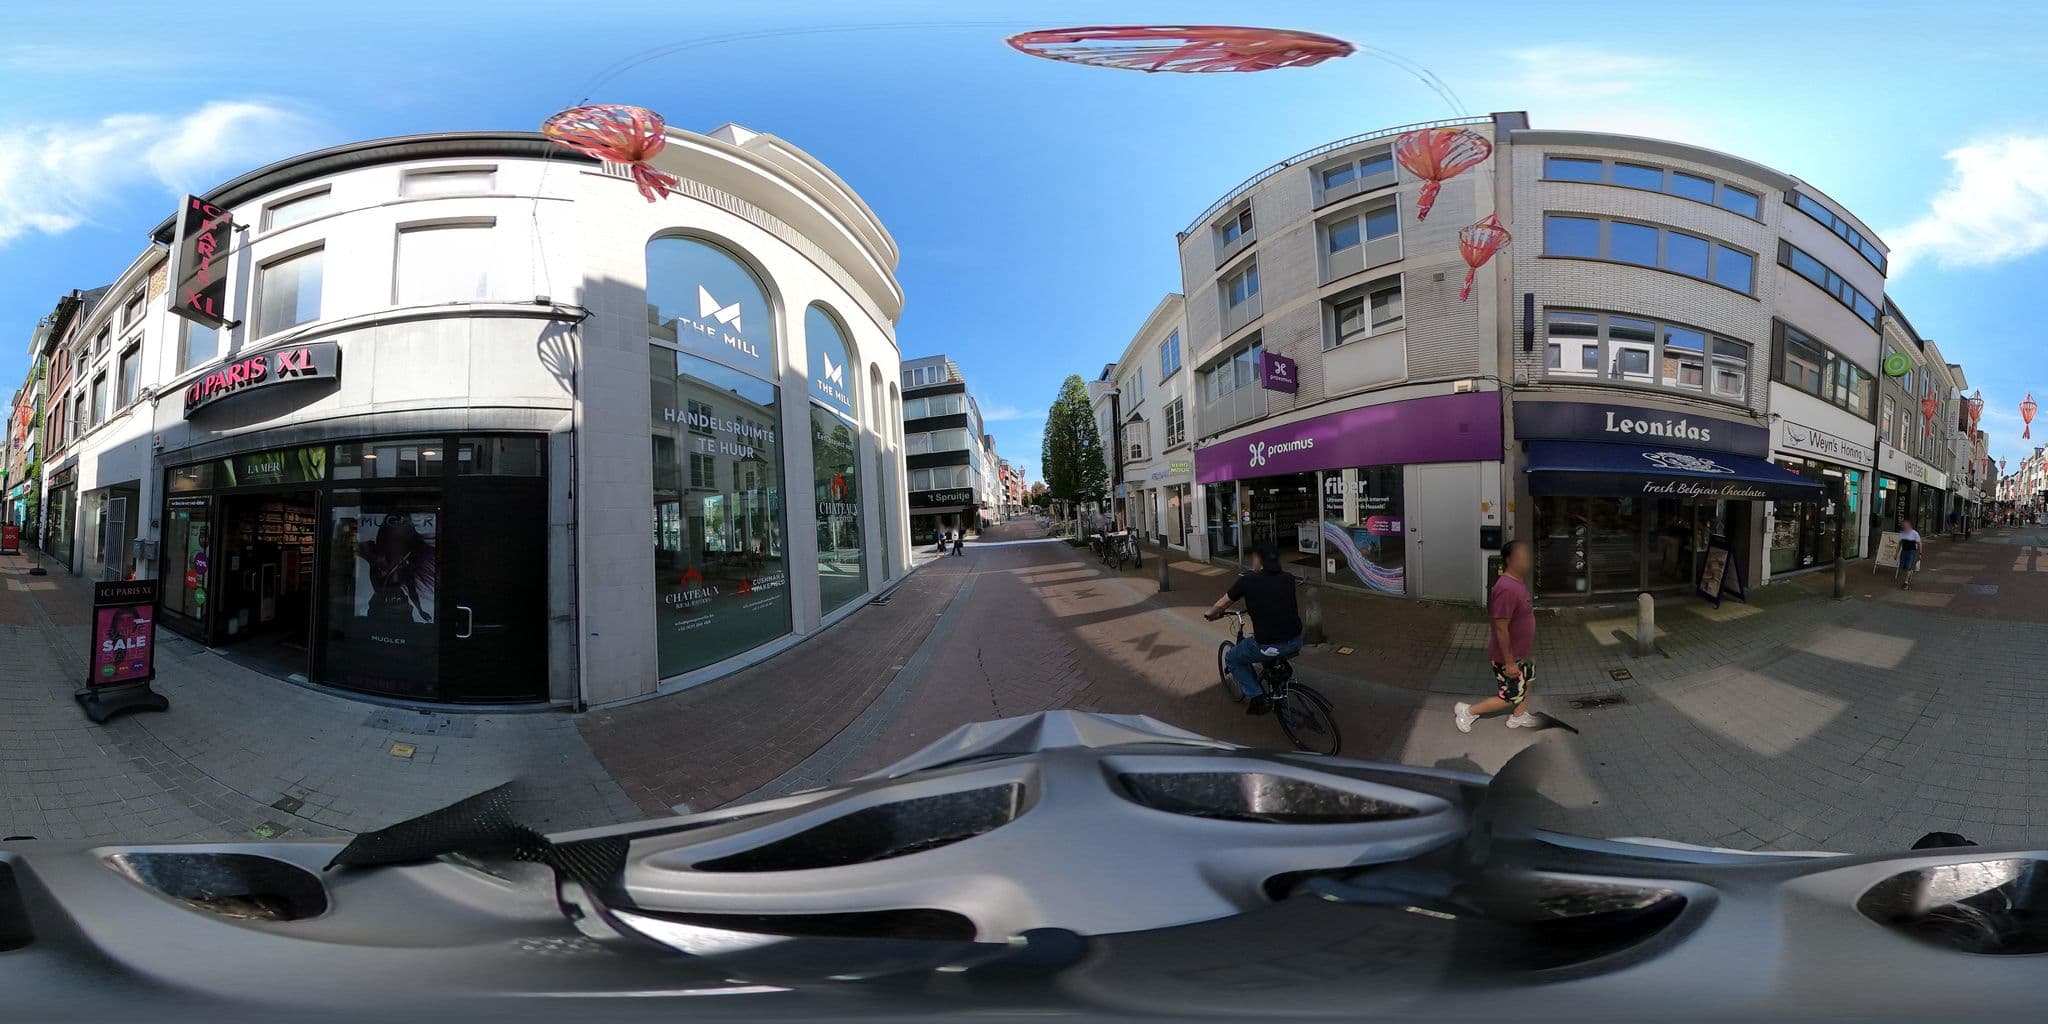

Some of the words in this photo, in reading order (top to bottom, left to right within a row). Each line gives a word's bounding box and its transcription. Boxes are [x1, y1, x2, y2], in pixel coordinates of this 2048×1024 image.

[192, 199, 230, 224] ICI
[184, 288, 219, 318] XL
[678, 316, 716, 336] THE
[723, 332, 759, 358] MILL
[184, 382, 202, 406] ICI
[204, 355, 268, 396] PARIS
[276, 346, 316, 374] XL
[817, 379, 833, 396] THE
[834, 389, 852, 408] MILL
[663, 407, 775, 443] HANDELSRUIMTE
[1604, 411, 1712, 443] Leonidas
[697, 437, 717, 453] TE
[719, 439, 755, 460] HUUR
[1267, 437, 1314, 459] proximus
[1808, 429, 1839, 454] Weyn's
[1840, 440, 1863, 463] Honing
[247, 464, 259, 475] LA
[260, 461, 281, 474] MER
[1904, 459, 1924, 479] veritas
[1324, 476, 1368, 495] fiber
[1642, 480, 1675, 494] Fresh
[1676, 482, 1719, 498] Belgian
[1720, 485, 1768, 498] Chocolates
[935, 491, 970, 503] Spruitje
[819, 501, 859, 517] CHATEAUX
[752, 574, 781, 586] CUSHMAN
[101, 588, 114, 598] ICI
[116, 587, 140, 597] PARIS
[142, 586, 152, 594] XL
[665, 585, 720, 604] CHATEAUX
[102, 636, 147, 652] SALE
[371, 635, 406, 645] MUGLER
